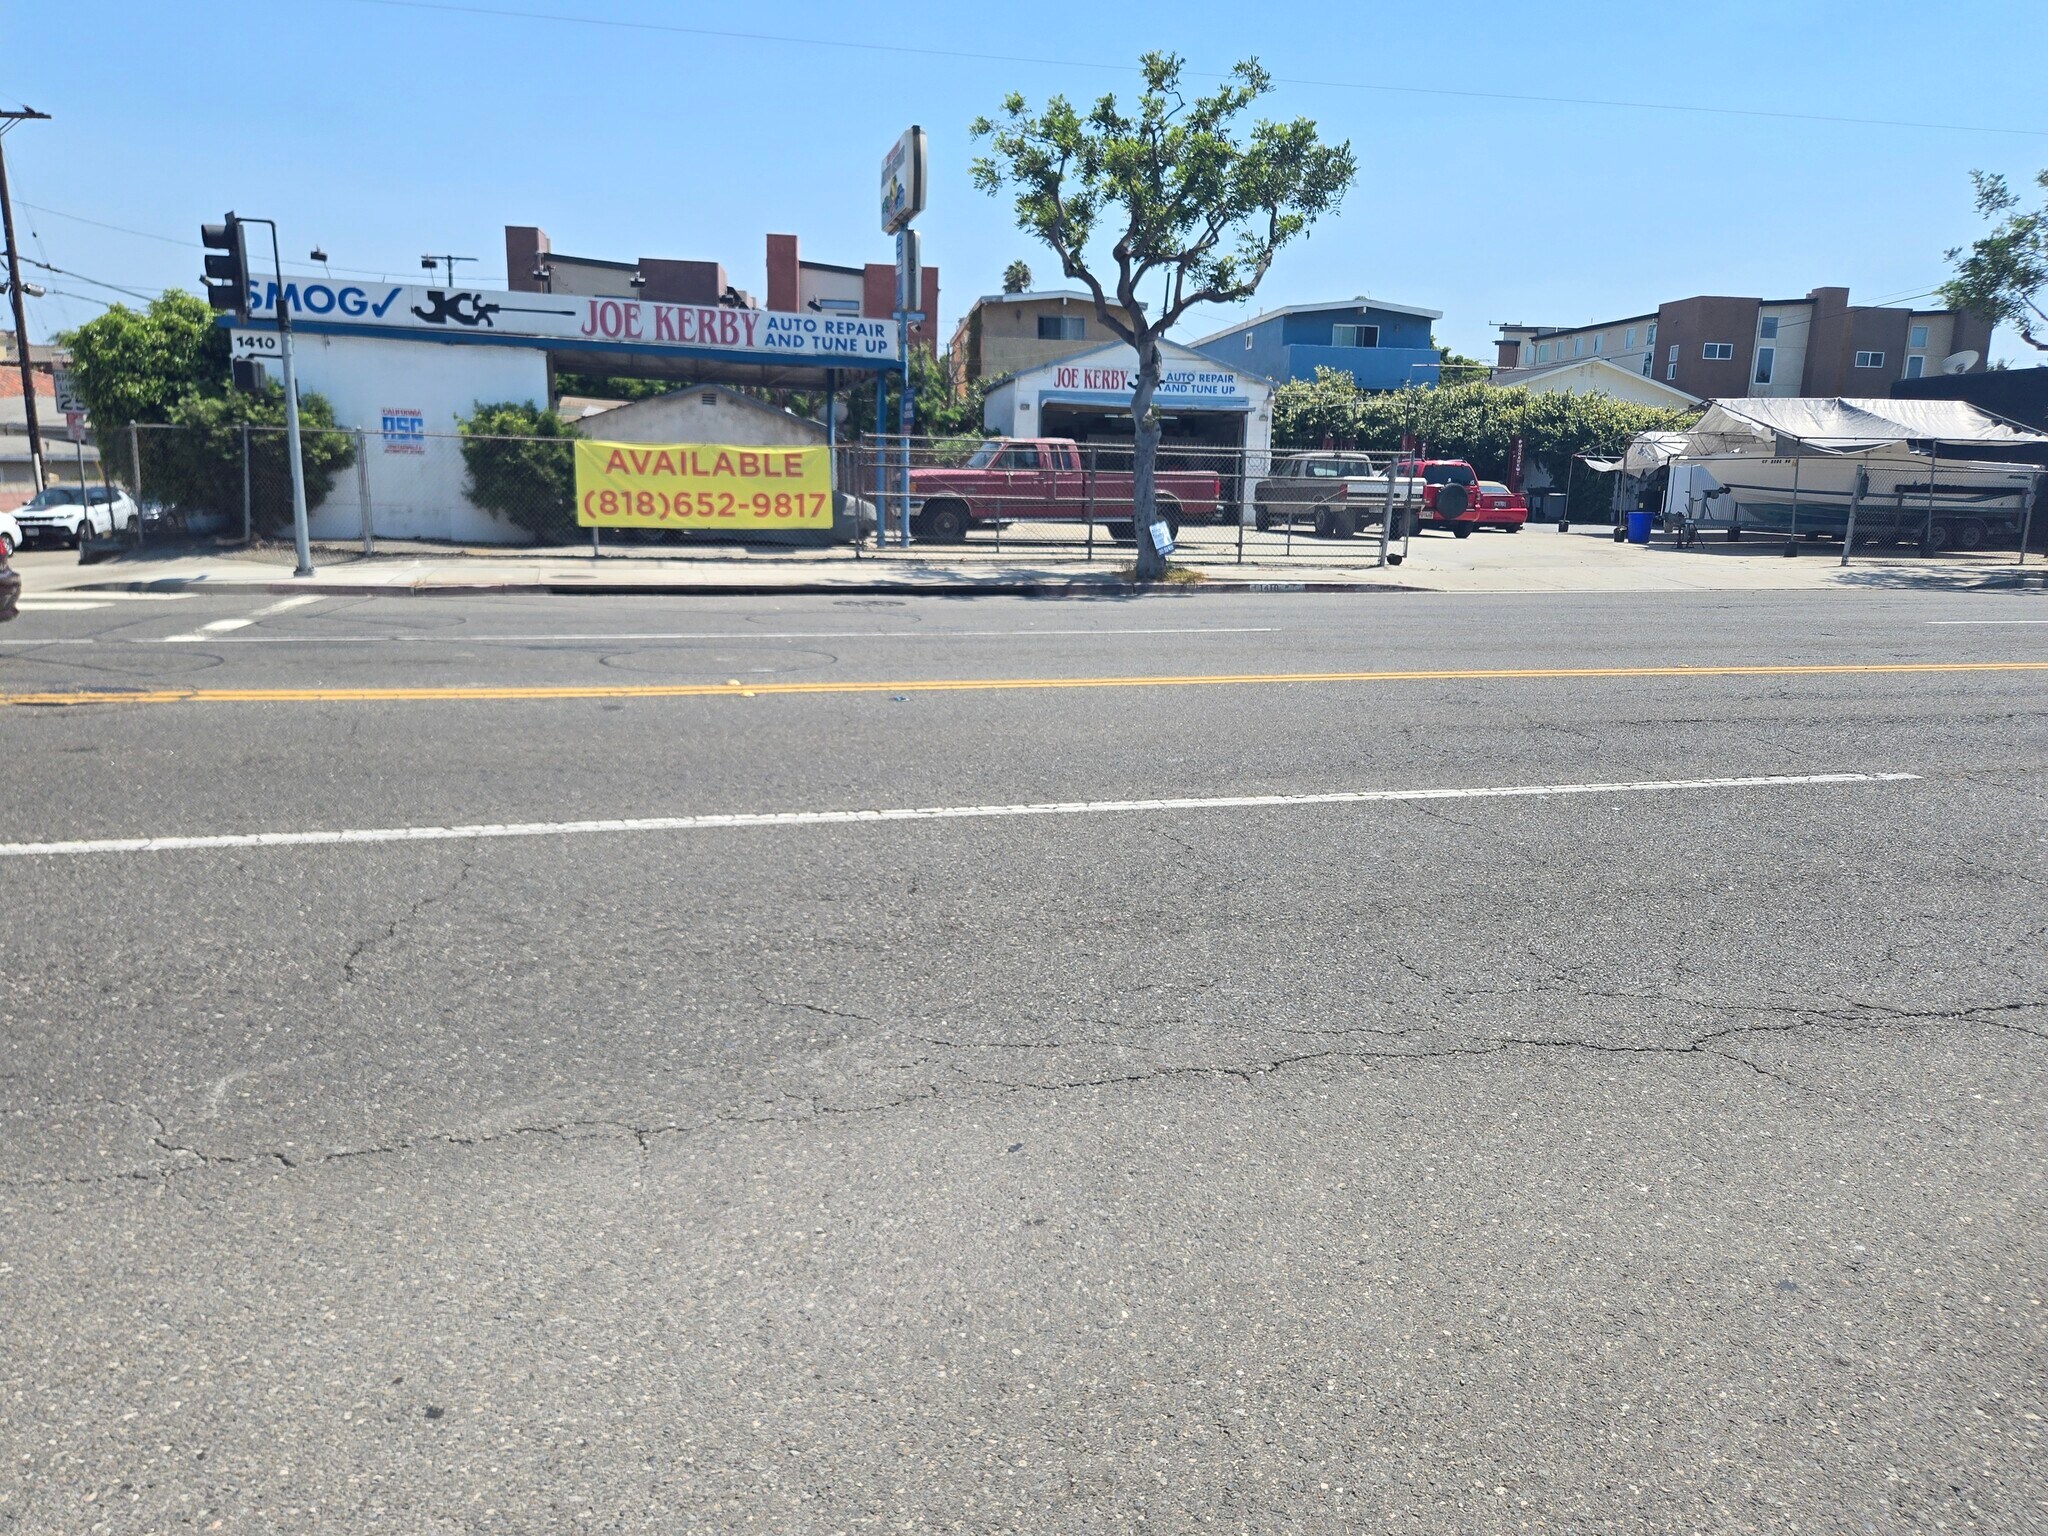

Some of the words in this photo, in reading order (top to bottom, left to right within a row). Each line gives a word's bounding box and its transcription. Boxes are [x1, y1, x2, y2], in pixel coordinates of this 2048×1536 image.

[249, 280, 368, 317] SMOG
[581, 300, 644, 339] JOE
[653, 305, 760, 347] KERBY
[767, 317, 817, 333] AUTO
[825, 321, 885, 338] REPAIR
[236, 335, 276, 350] 1410
[764, 333, 805, 348] AND
[812, 336, 857, 352] TUNE
[865, 340, 888, 354] UP
[1054, 367, 1079, 389] JOE
[1084, 369, 1129, 391] KERBY
[1163, 383, 1188, 393] AND
[1191, 385, 1219, 395] TUNE
[1221, 386, 1236, 395] UP
[1166, 372, 1196, 383] AUTO
[1199, 374, 1235, 384] REPAIR
[605, 449, 803, 478] AVAILABLE
[584, 489, 826, 521] (818)652-9817
